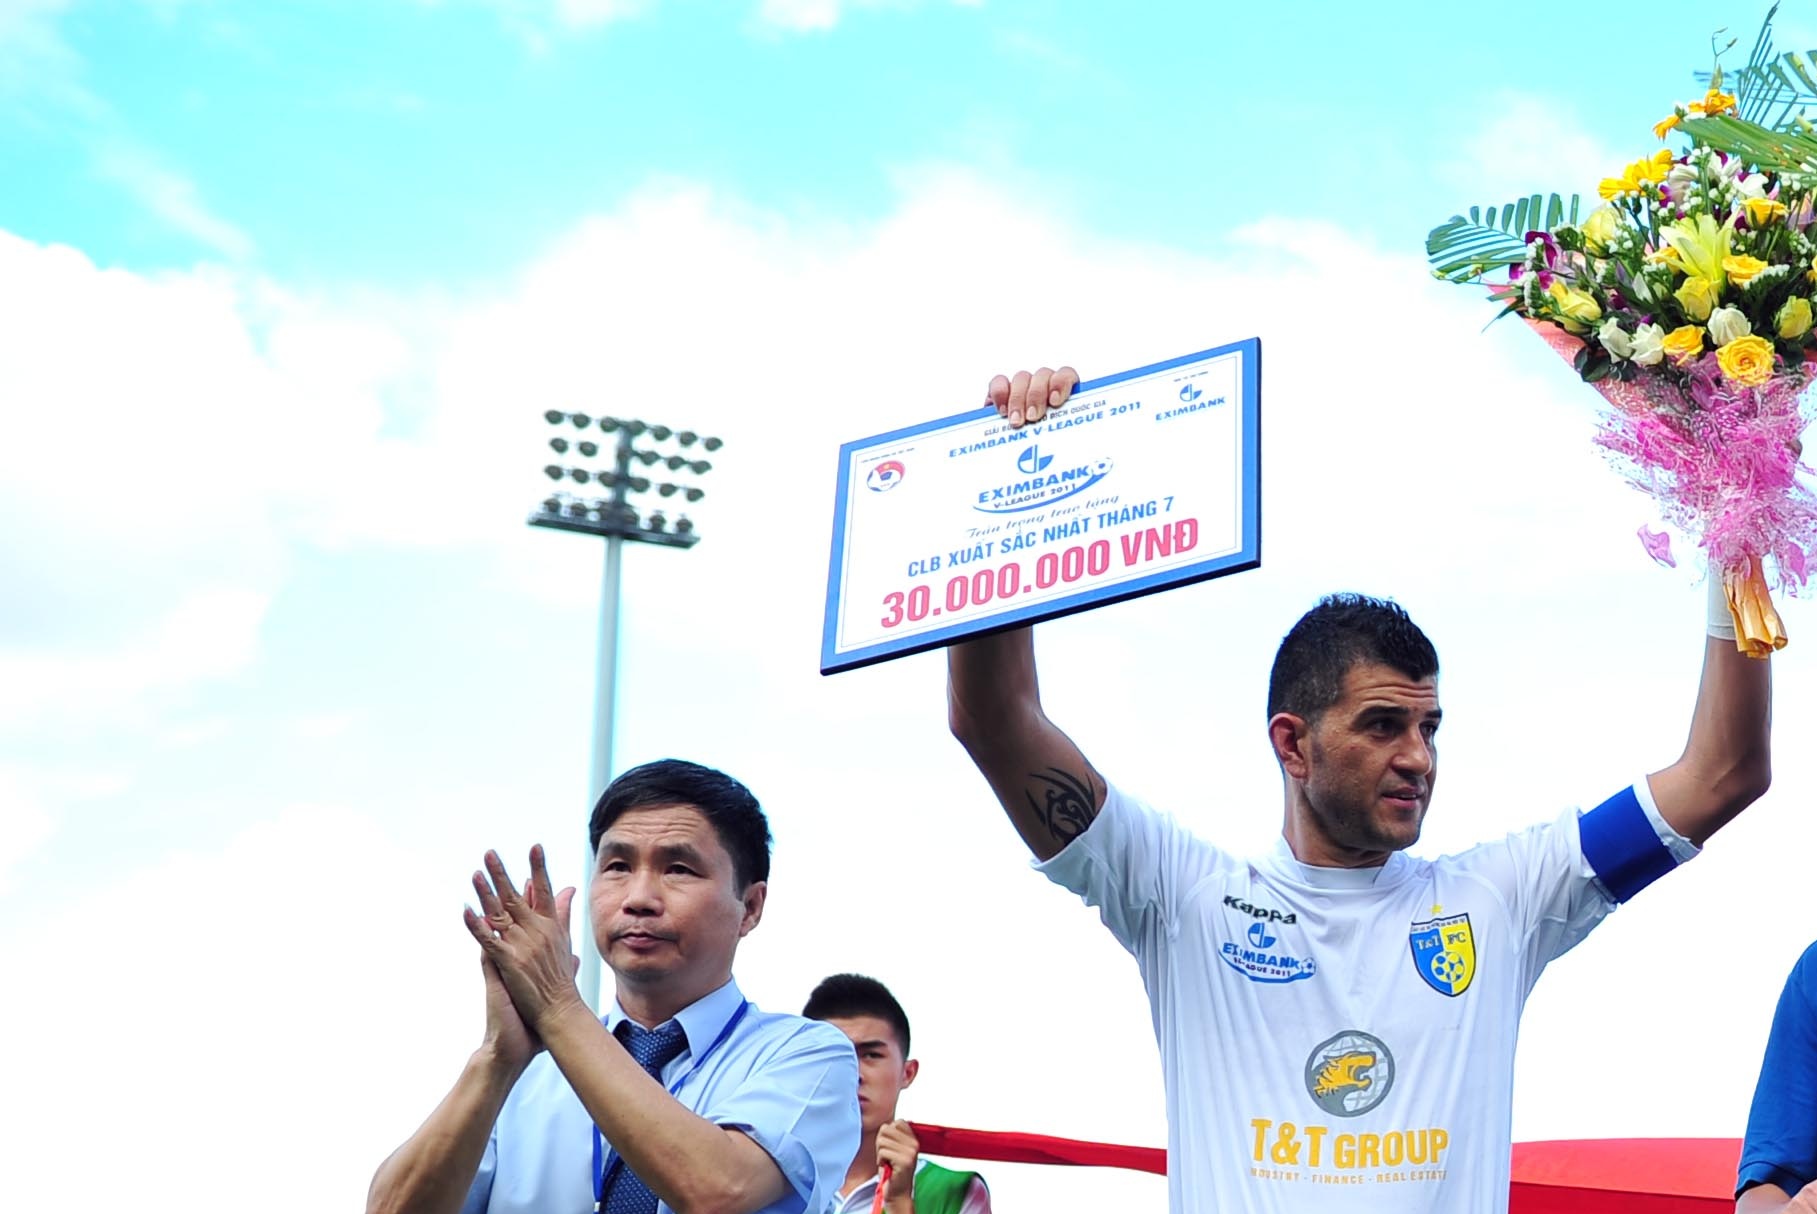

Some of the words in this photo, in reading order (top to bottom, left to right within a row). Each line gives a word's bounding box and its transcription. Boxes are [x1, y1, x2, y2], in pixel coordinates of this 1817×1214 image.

[1155, 397, 1226, 421] EXIMBANK
[949, 430, 1028, 457] EXIMBANK
[1033, 411, 1104, 436] V-LEAGUE
[1110, 401, 1142, 416] 2011
[978, 465, 1090, 503] EXIMBANK
[993, 490, 1046, 509] V-LEAGUE
[1050, 482, 1077, 496] 2011
[907, 555, 941, 577] CLB
[948, 538, 993, 568] XUẤT
[1000, 527, 1037, 554] SẮC
[1043, 513, 1091, 543] NHẤT
[1097, 500, 1158, 529] THÁNG
[1163, 496, 1175, 512] 7
[881, 540, 1111, 628] 30.000.000
[1121, 517, 1199, 567] VNĐ
[1223, 895, 1297, 924] Kappa
[1447, 932, 1467, 945] FC
[1251, 1118, 1328, 1168] T&T
[1333, 1128, 1449, 1169] GROUP
[1376, 1171, 1406, 1183] REAL
